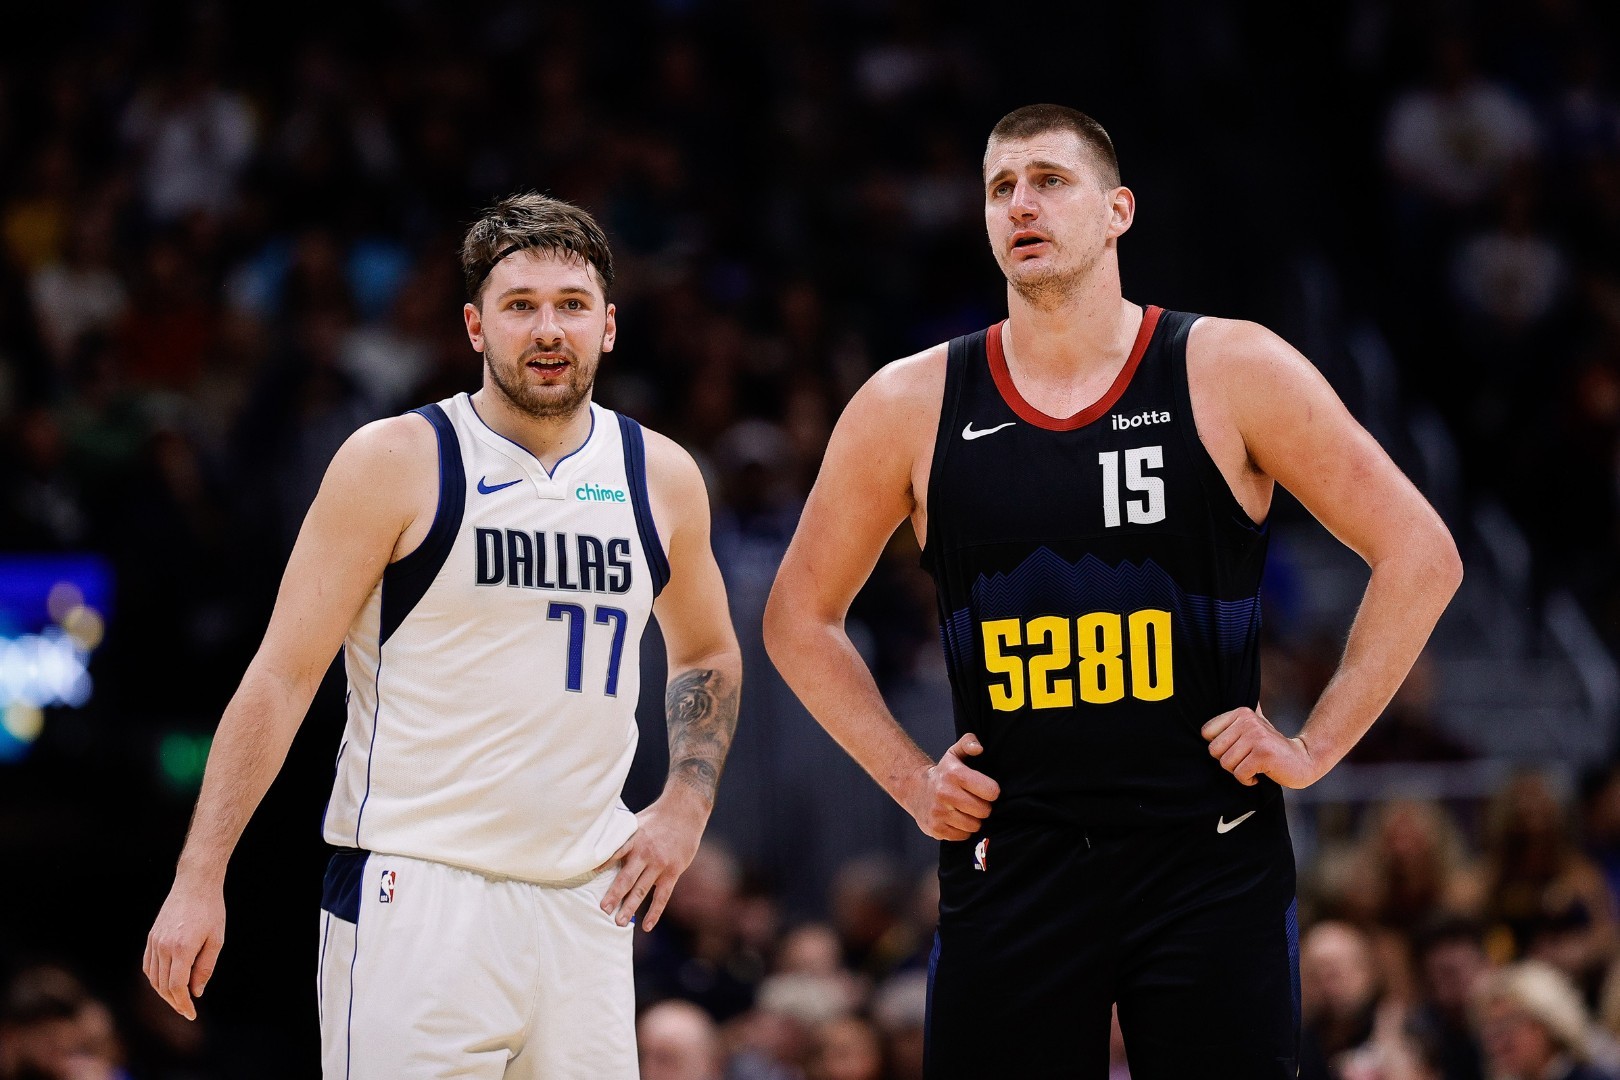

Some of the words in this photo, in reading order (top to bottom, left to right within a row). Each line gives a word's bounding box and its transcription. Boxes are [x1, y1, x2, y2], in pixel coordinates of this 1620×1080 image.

[1111, 411, 1171, 431] ibotta
[576, 483, 626, 503] chime
[1099, 445, 1166, 527] 15
[474, 526, 633, 595] DALLAS
[546, 600, 629, 698] 77
[981, 608, 1174, 712] 5280
